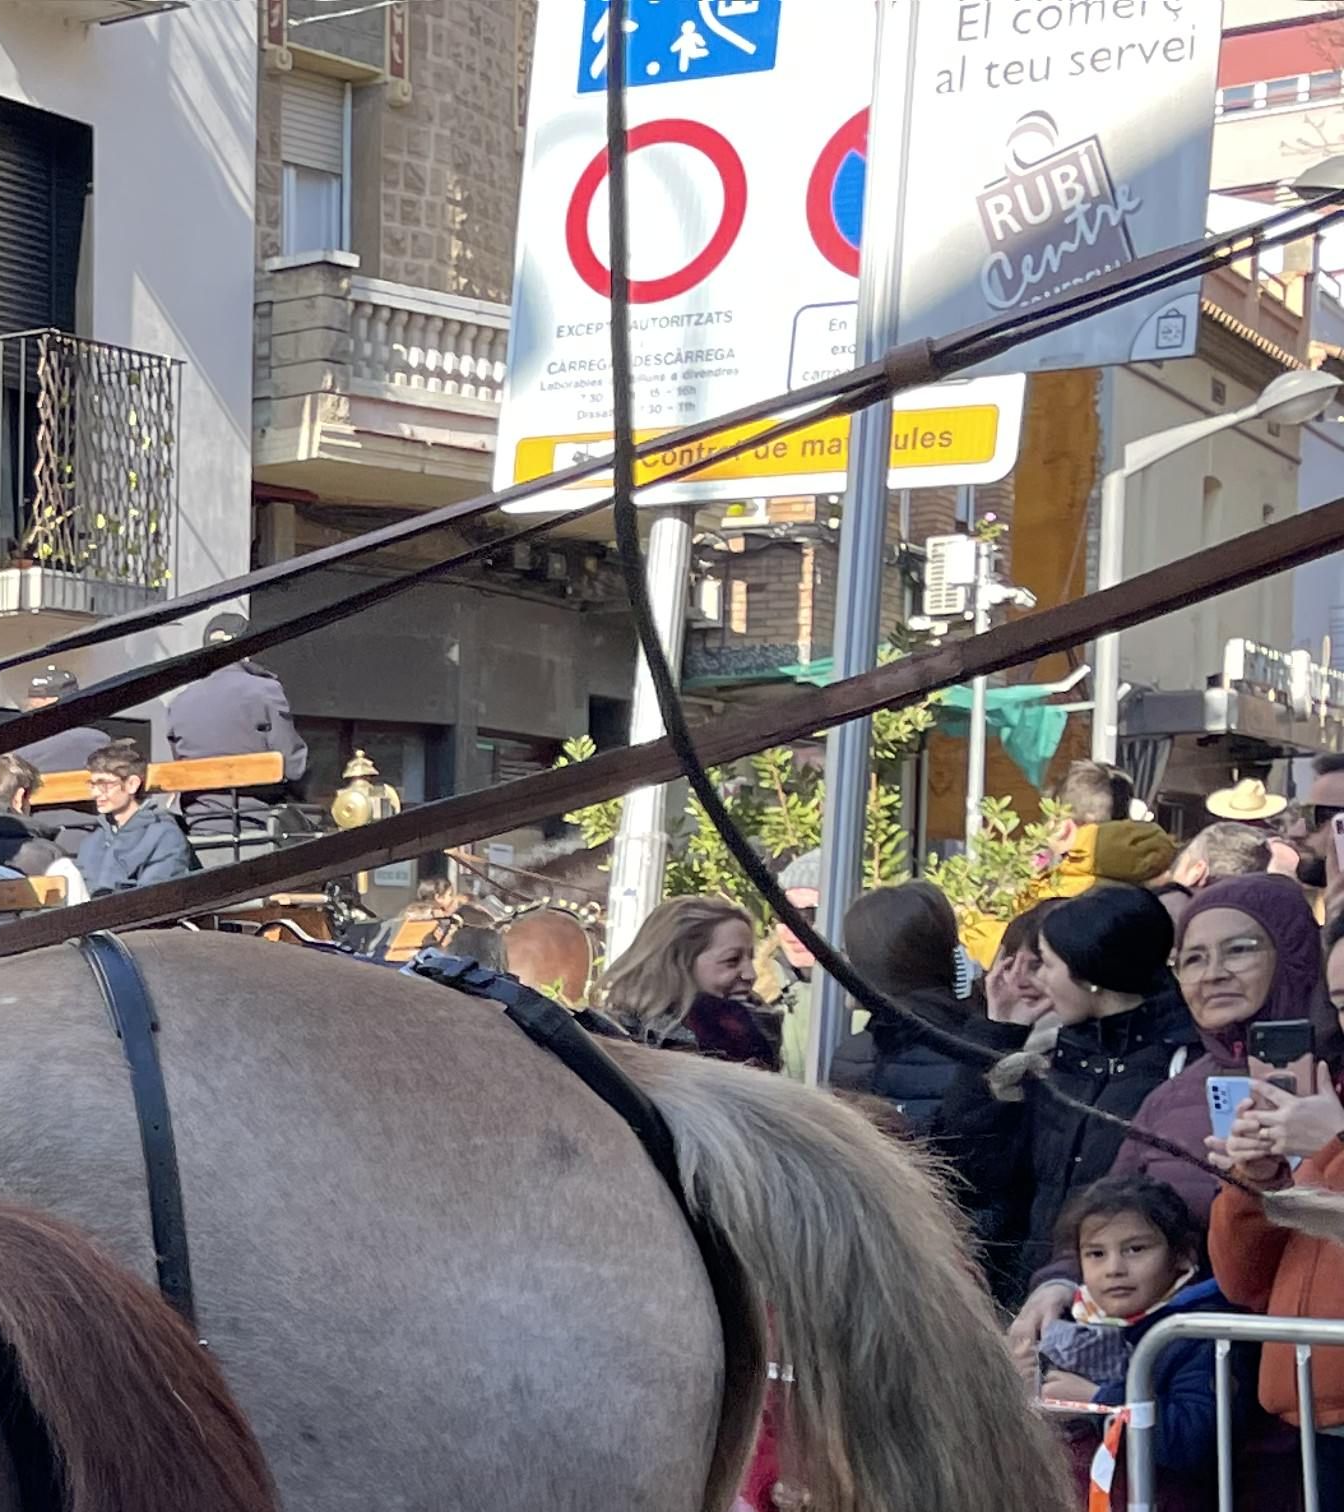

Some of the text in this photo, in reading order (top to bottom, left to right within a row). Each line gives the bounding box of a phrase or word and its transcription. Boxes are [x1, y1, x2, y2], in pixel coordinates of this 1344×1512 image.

[934, 23, 1197, 94] al teu servei
[957, 2, 992, 42] El
[983, 143, 1102, 242] RUBÍ
[979, 183, 1144, 311] Centre
